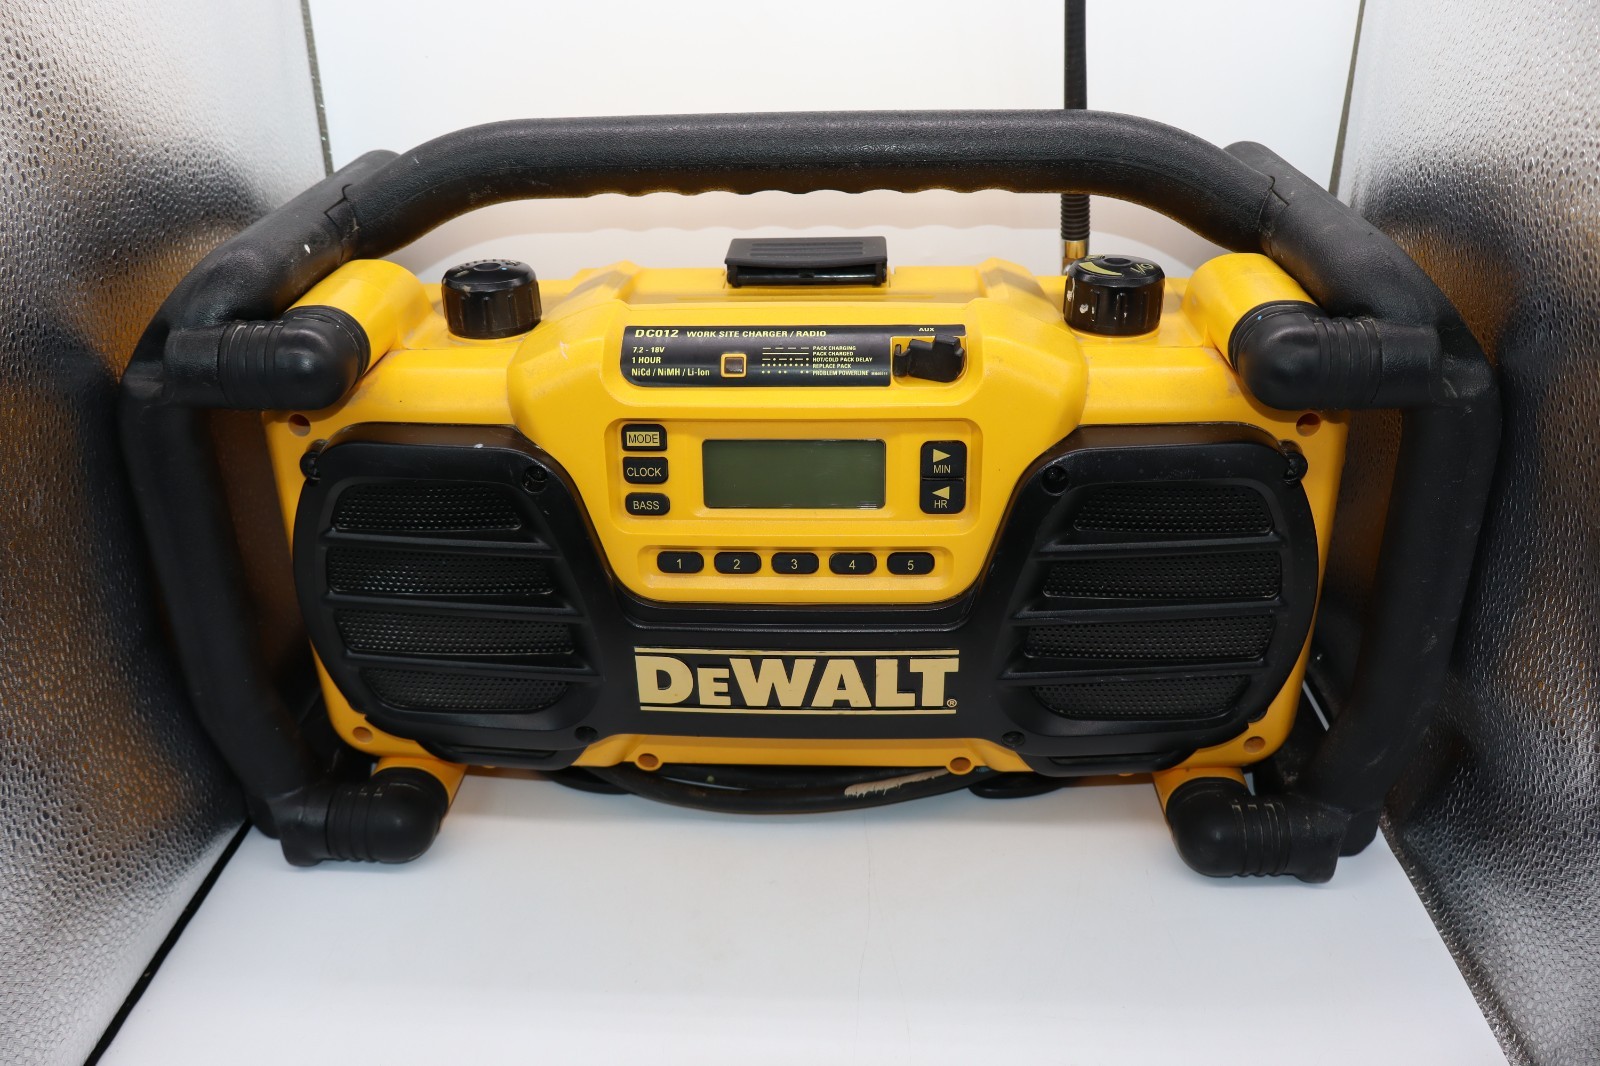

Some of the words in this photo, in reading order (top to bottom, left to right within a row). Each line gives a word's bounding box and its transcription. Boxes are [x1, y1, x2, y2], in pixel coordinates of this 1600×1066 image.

[634, 330, 679, 338] DC012
[632, 368, 650, 376] NiCd
[658, 368, 680, 376] NiMH
[688, 368, 710, 376] Li-Ion
[628, 434, 659, 444] MODE
[626, 467, 662, 478] CLOCK
[933, 464, 951, 474] MIN
[632, 500, 660, 510] BASS
[934, 499, 948, 509] HR
[676, 558, 682, 569] 1
[733, 559, 741, 570] 2
[791, 559, 798, 570] 3
[848, 560, 856, 570] 4
[907, 560, 914, 571] 5
